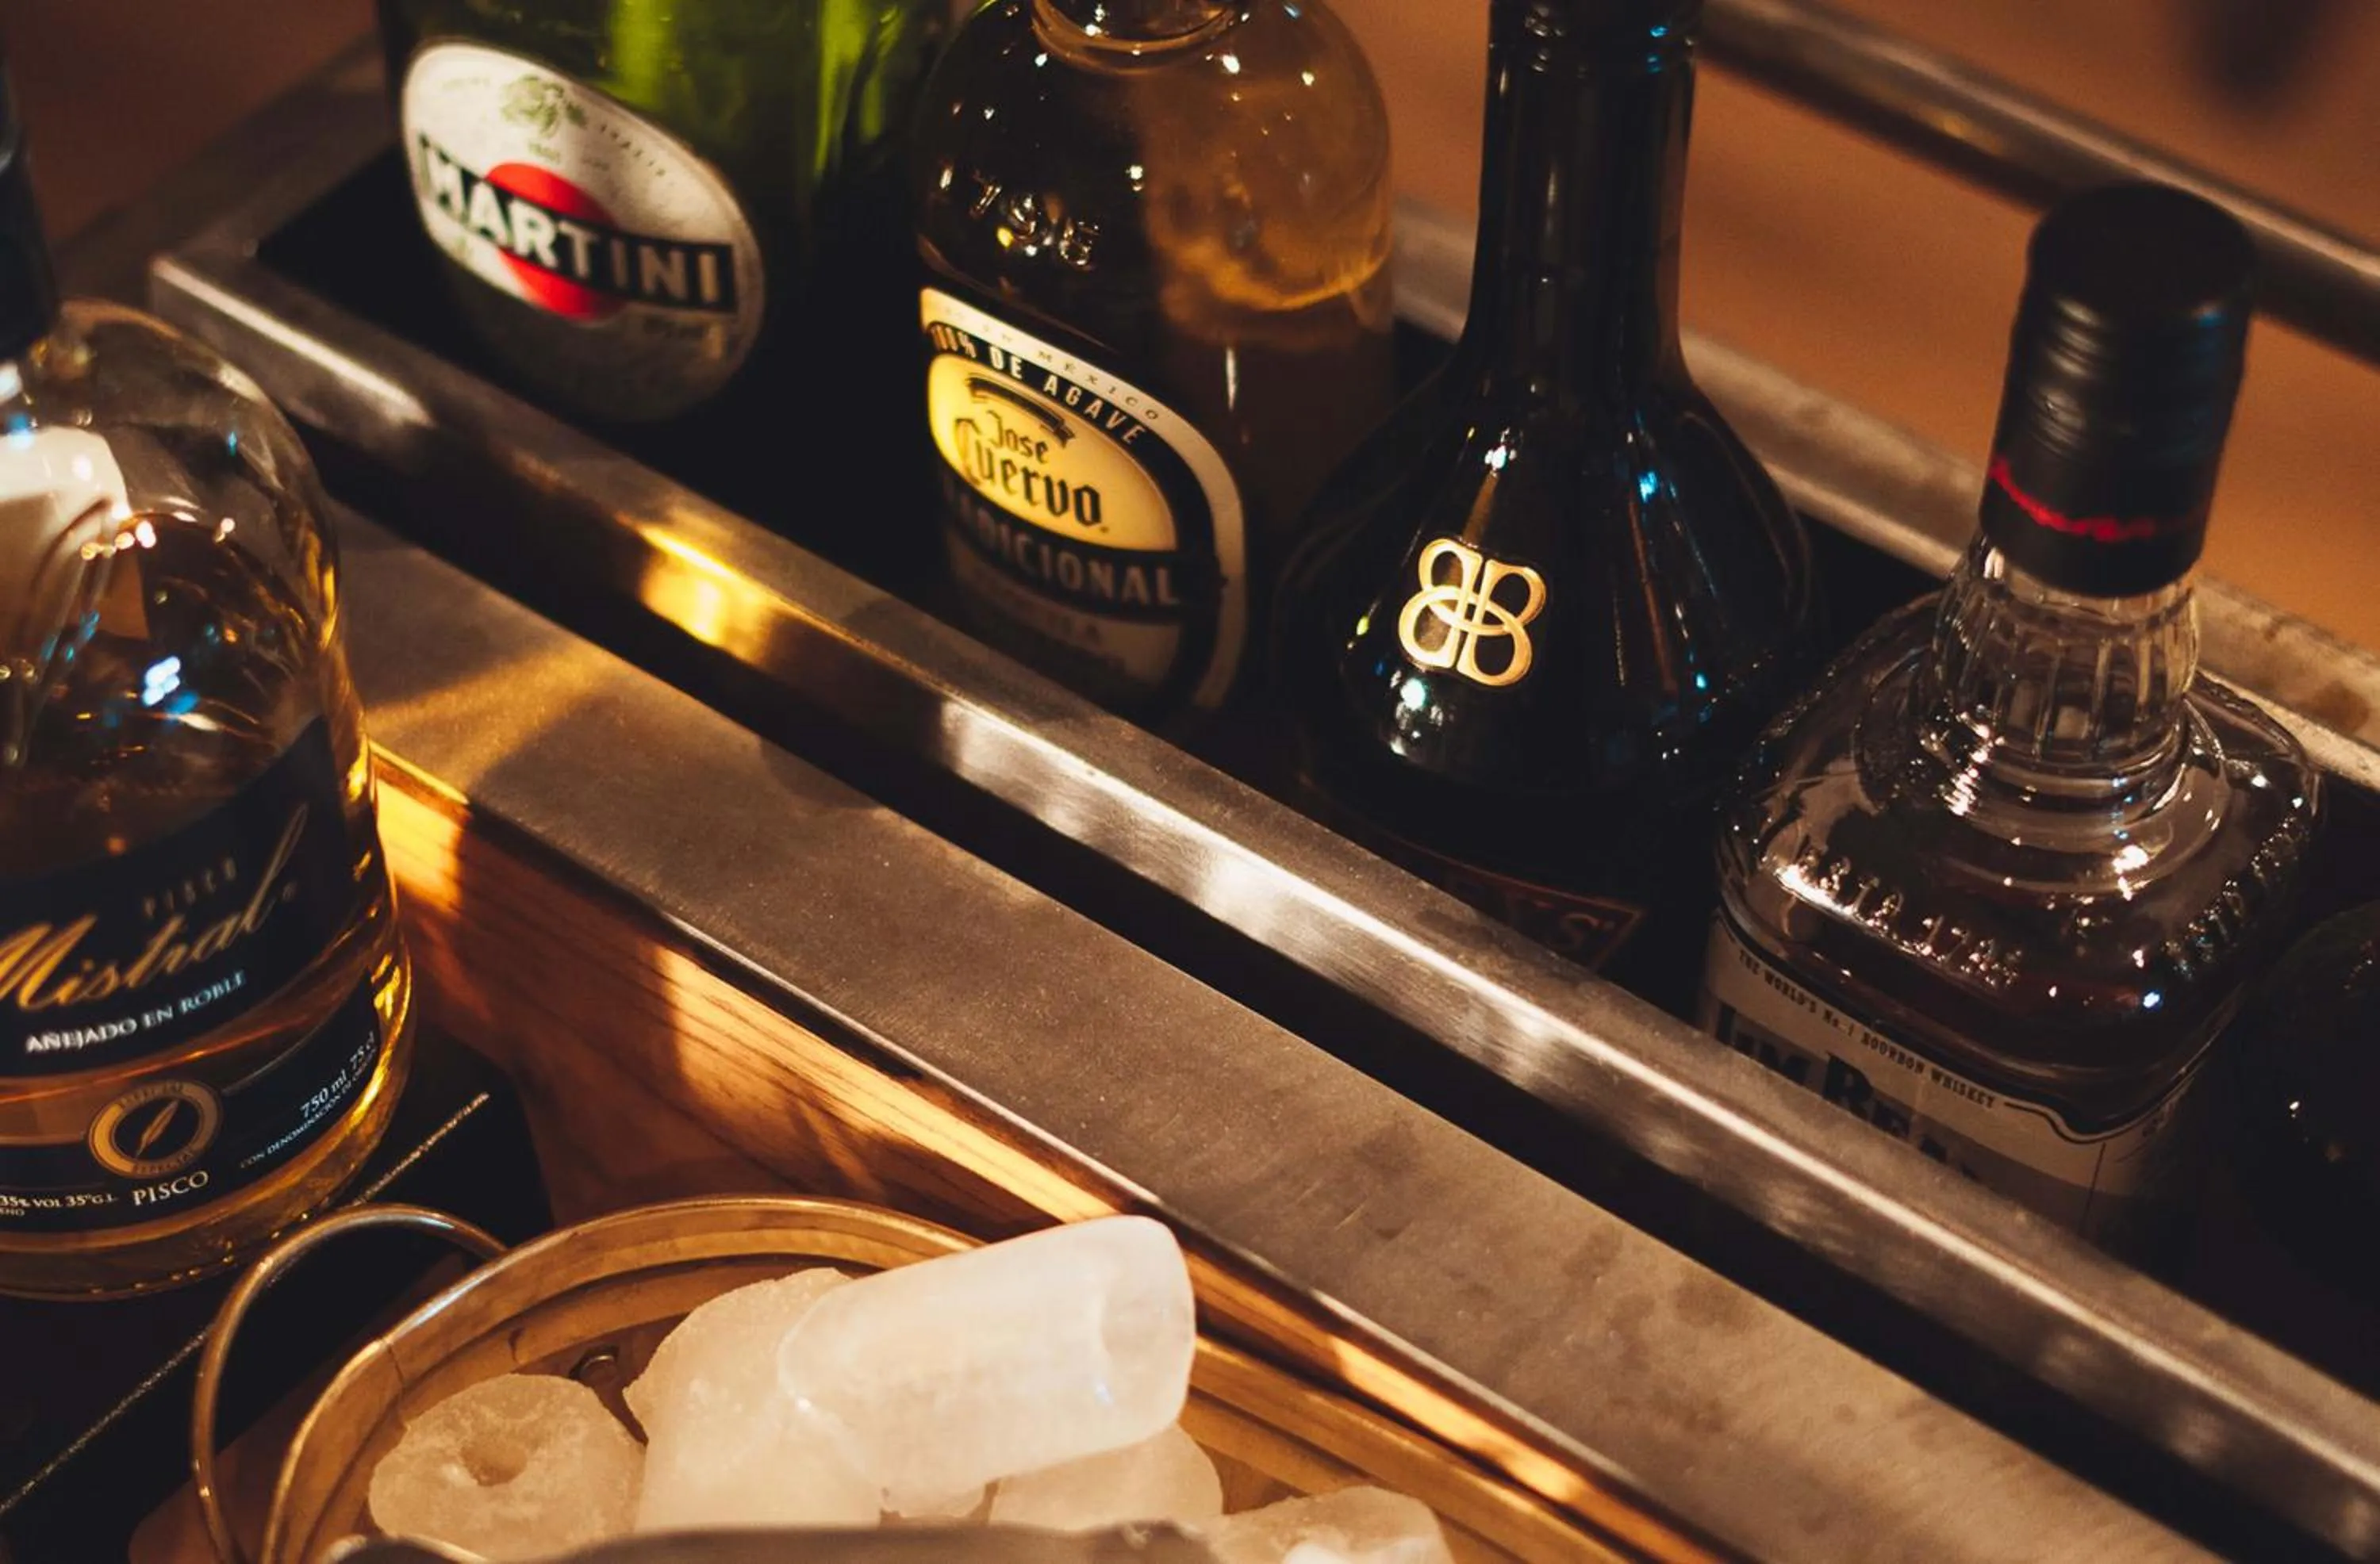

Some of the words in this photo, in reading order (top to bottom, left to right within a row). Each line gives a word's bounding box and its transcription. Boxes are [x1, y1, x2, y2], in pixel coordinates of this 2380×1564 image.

[420, 139, 721, 305] MARTINI
[990, 346, 1023, 379] DE
[1043, 375, 1147, 445] AGAVE
[954, 418, 1102, 527] Cuervo
[143, 1005, 174, 1029] EN
[179, 969, 247, 1014] ROBLE
[1739, 949, 1760, 976] THE
[1860, 1030, 1925, 1075] BOURBON
[1930, 1066, 1996, 1109] WHISKEY
[300, 1087, 329, 1119] 750
[330, 1069, 347, 1094] ml
[32, 1198, 63, 1208] VOL
[132, 1170, 210, 1206] PISCO
